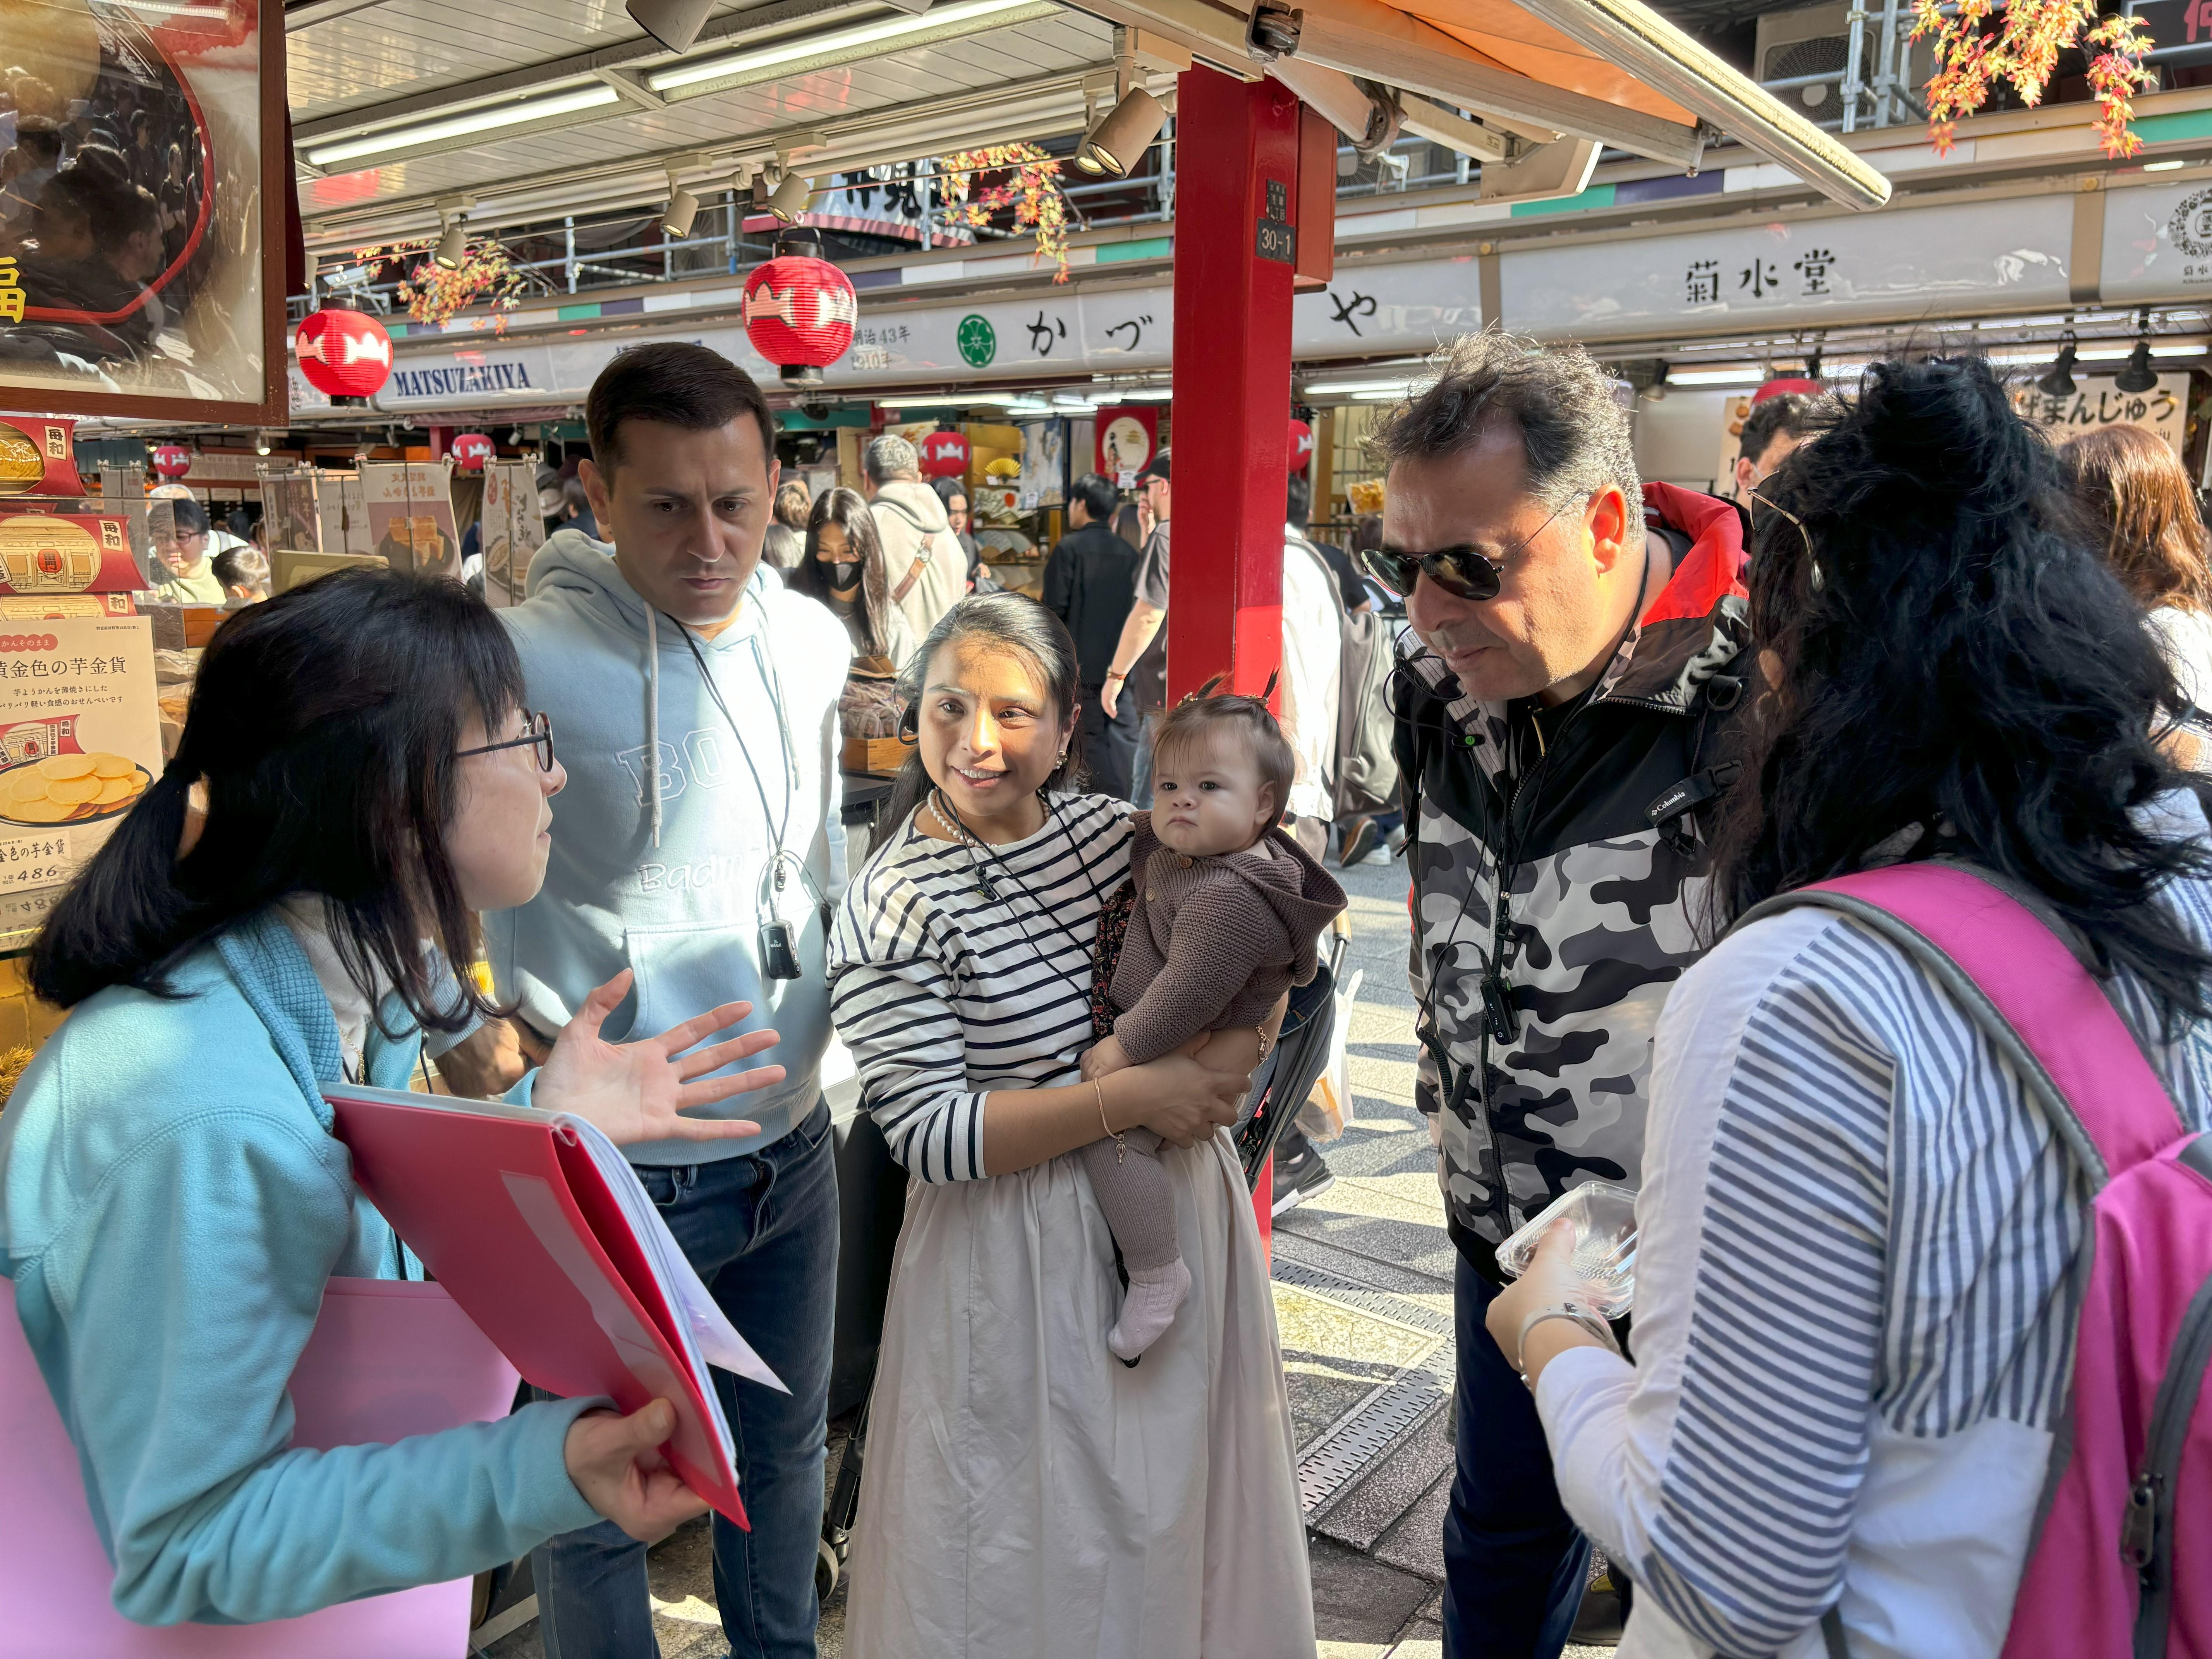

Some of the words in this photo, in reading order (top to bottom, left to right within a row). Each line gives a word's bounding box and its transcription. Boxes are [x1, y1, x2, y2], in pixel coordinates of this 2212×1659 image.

[1261, 228, 1291, 255] 30-1
[1686, 249, 1835, 303] 菊水堂
[393, 362, 531, 397] MATSUZAKIYA
[1656, 792, 1685, 812] Columbia
[17, 865, 57, 881] 486
